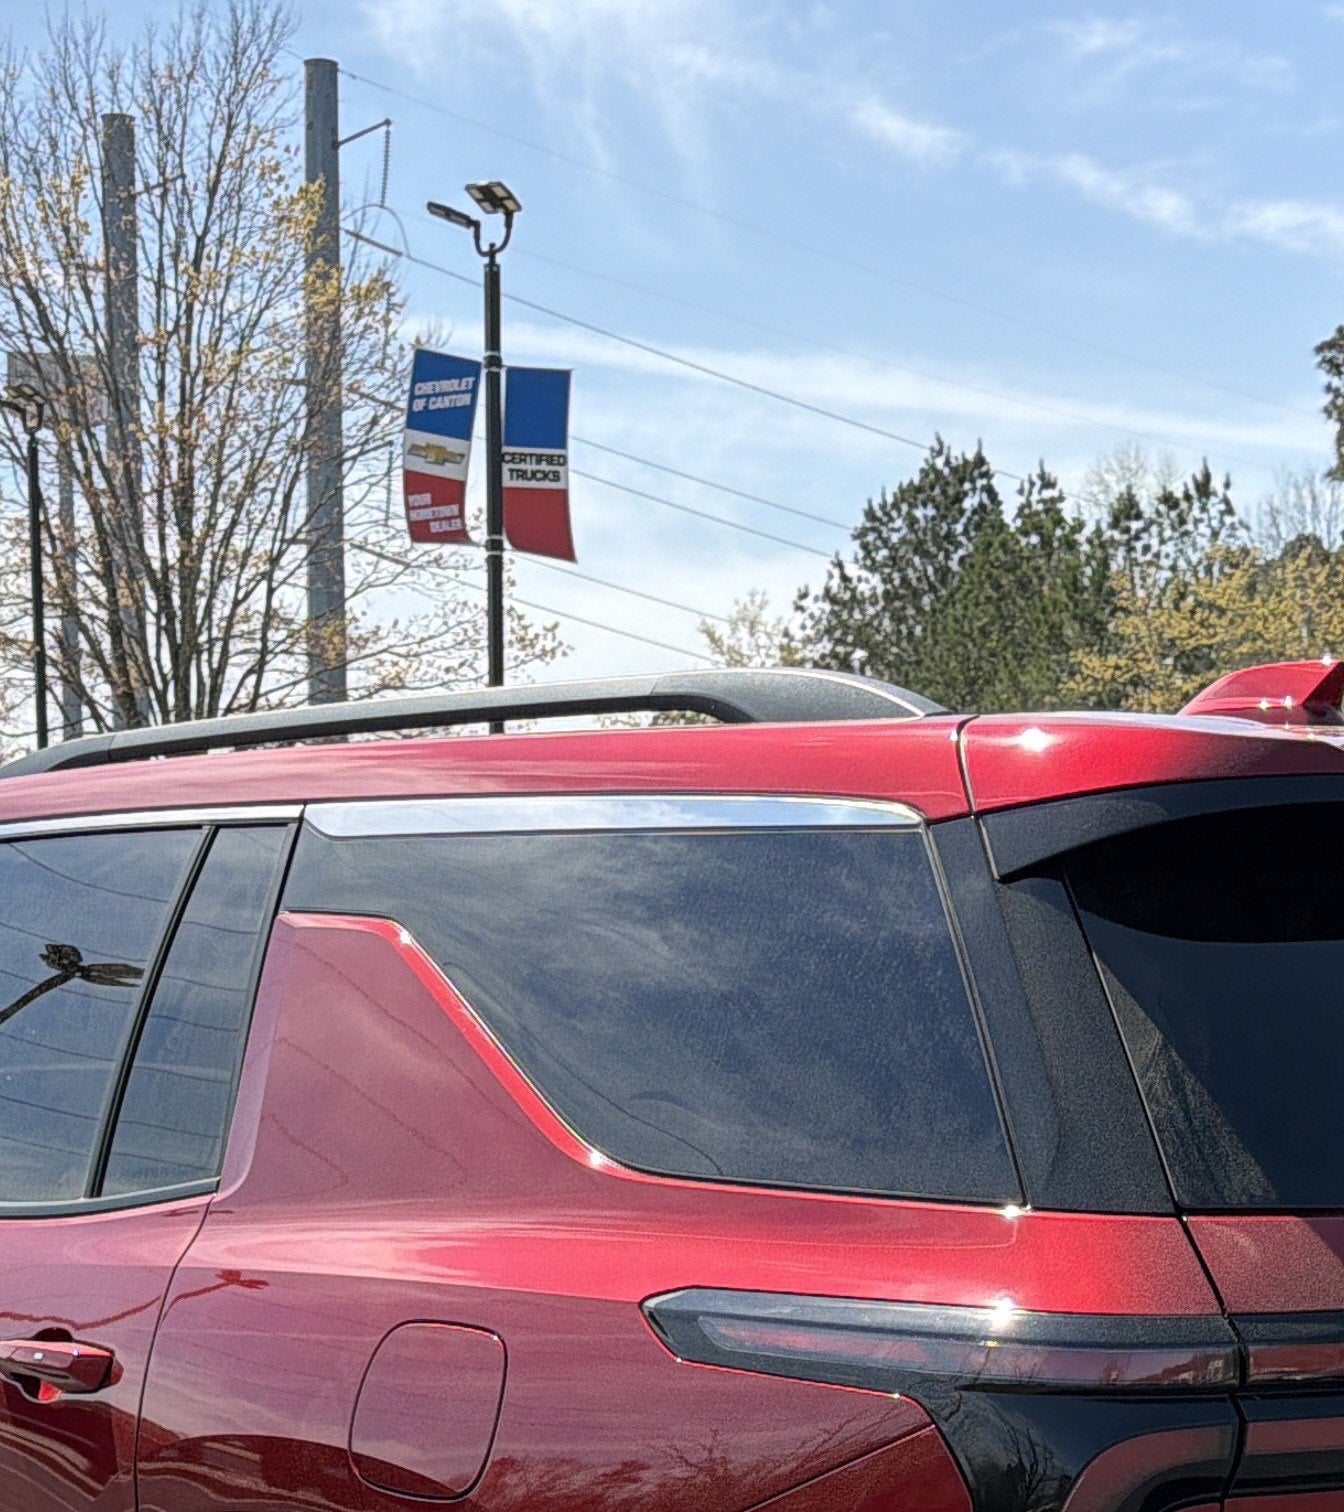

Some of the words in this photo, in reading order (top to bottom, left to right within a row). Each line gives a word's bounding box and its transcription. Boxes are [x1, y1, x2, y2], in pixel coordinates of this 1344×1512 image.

[414, 377, 475, 396] CHEVROLET
[413, 397, 427, 412] OF
[502, 453, 566, 467] CERTIFIED
[508, 469, 561, 482] TRUCKS
